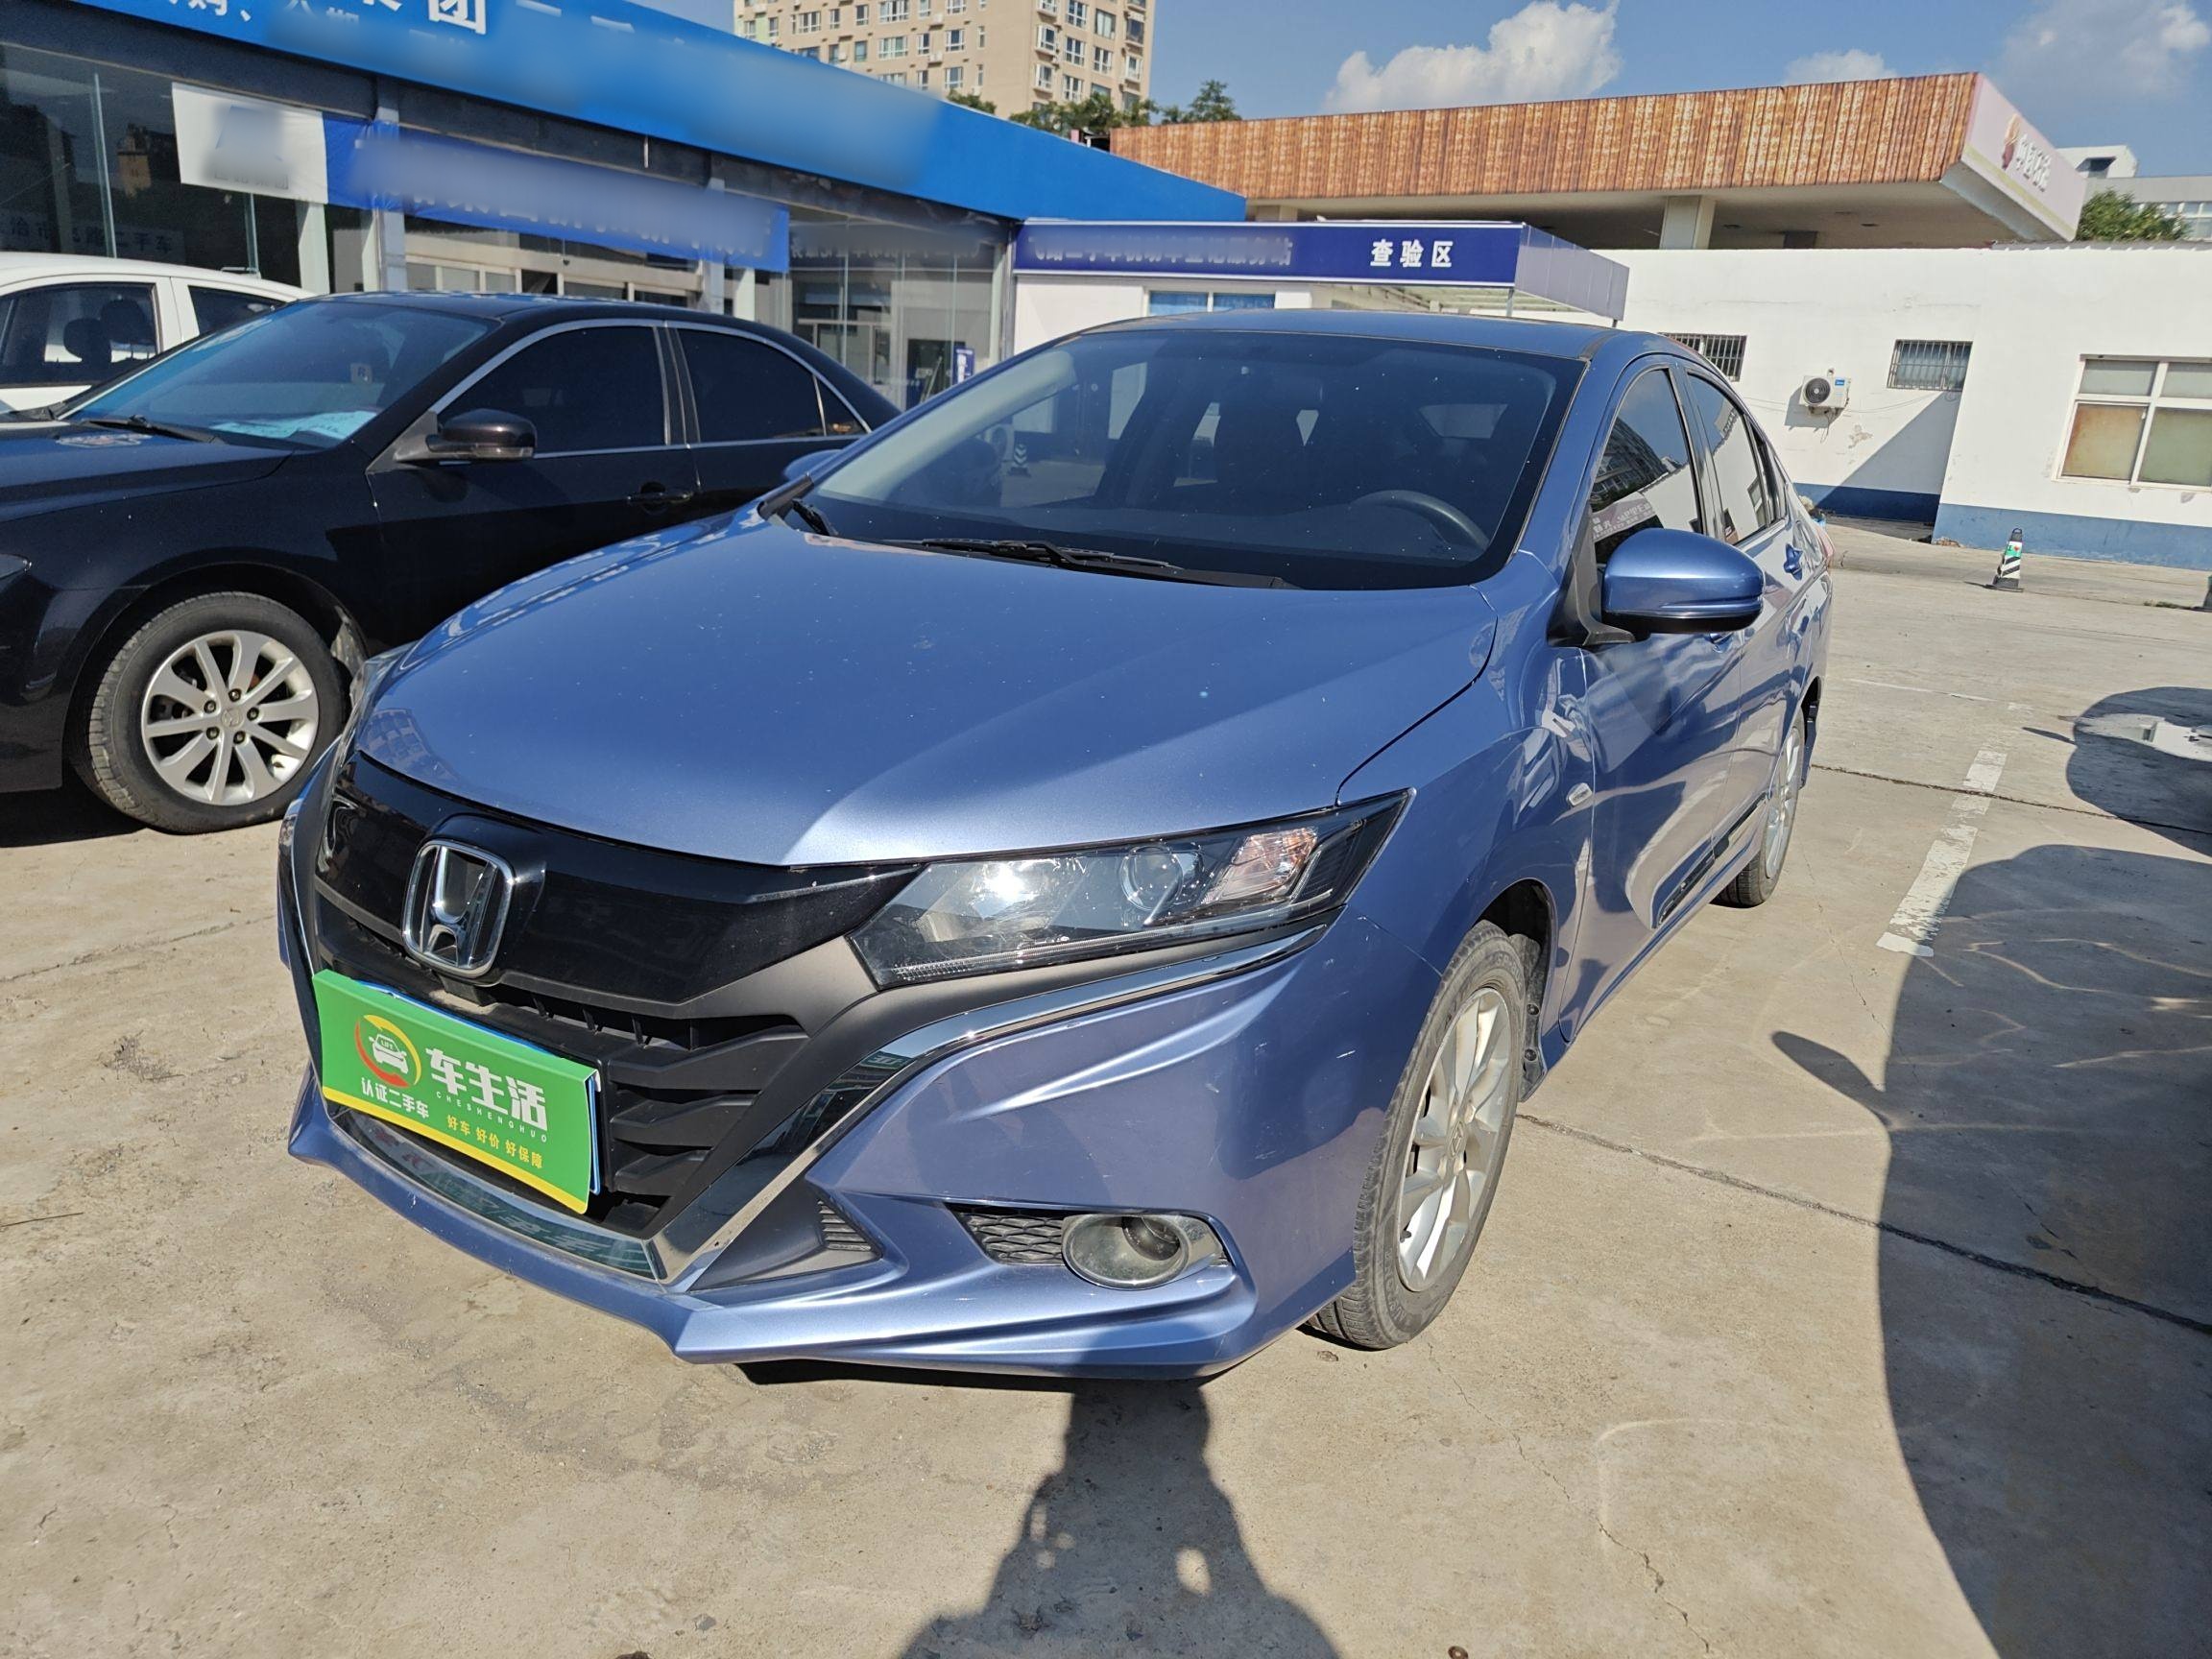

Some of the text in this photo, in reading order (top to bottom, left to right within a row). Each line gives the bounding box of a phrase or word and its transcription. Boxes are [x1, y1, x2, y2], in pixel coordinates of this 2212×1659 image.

[1370, 238, 1454, 268] 查验区
[361, 1077, 429, 1118] 认证二手车
[425, 1047, 548, 1131] 车生活
[436, 1091, 547, 1142] CHESHENGHUO
[446, 1114, 543, 1169] 好车 好价 好保障
